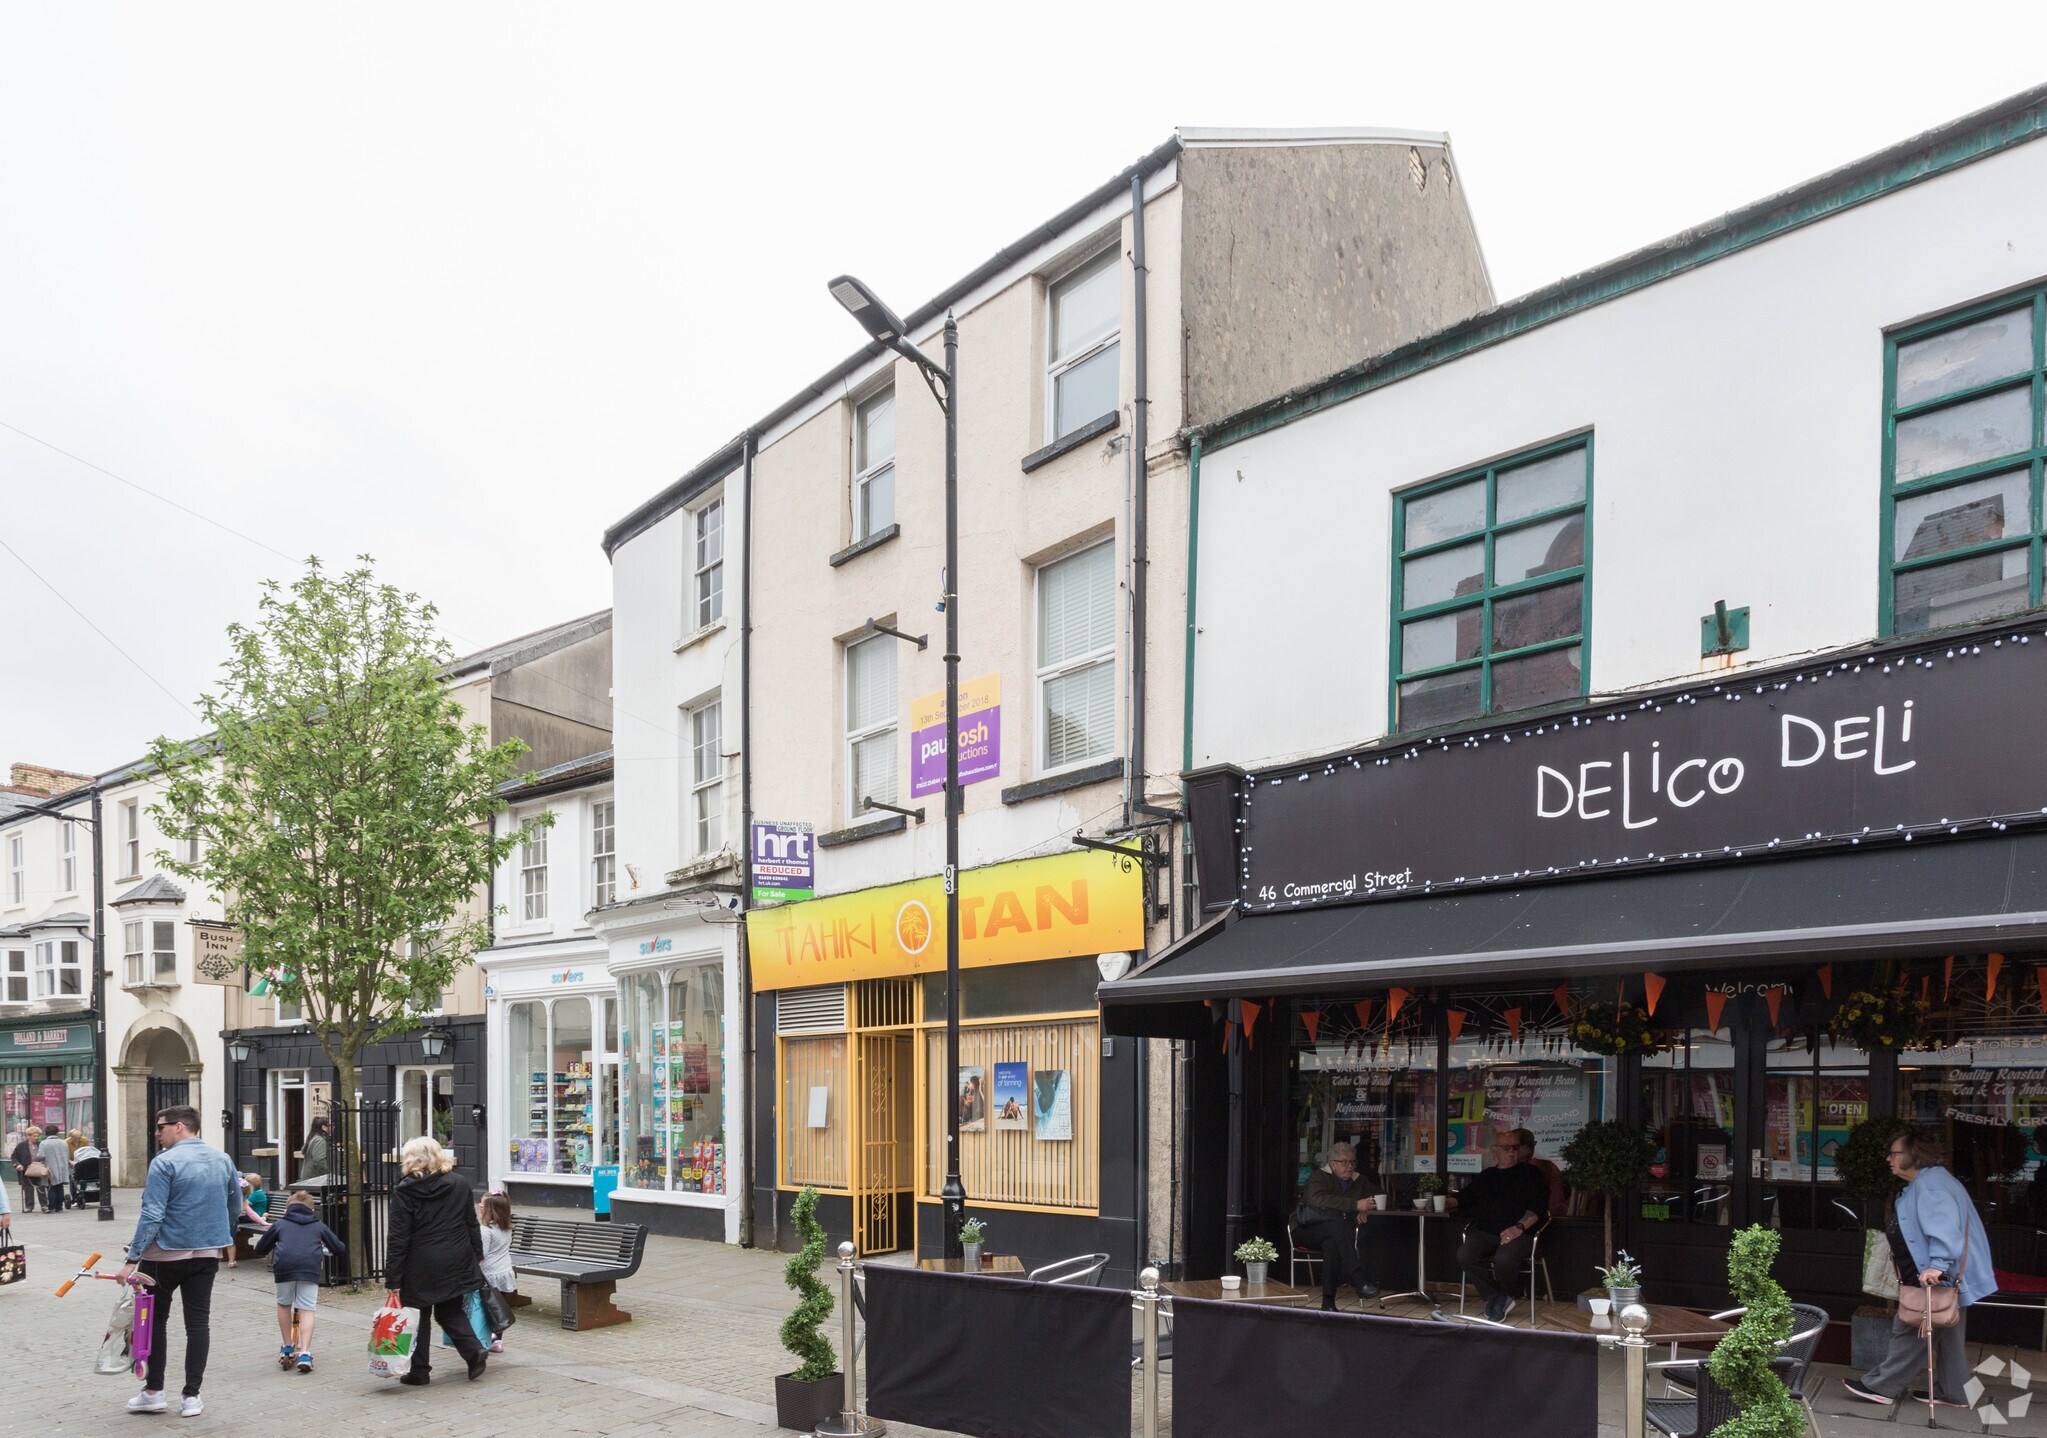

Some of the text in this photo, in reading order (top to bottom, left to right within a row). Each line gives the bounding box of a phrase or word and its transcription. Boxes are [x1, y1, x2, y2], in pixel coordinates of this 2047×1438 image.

[935, 702, 970, 719] Sepber
[972, 695, 989, 708] 2018
[921, 721, 988, 764] pau osh
[958, 745, 988, 761] uctions
[757, 827, 809, 859] hrt
[760, 866, 803, 875] REDUCED
[1258, 885, 1277, 901] 46
[1284, 874, 1357, 898] Commercial
[775, 879, 1089, 965] TAHIKI TAN
[639, 936, 672, 955] savers
[551, 969, 584, 984] savers
[1318, 1063, 1329, 1073] A
[1335, 1062, 1382, 1073] VARIETY
[1947, 1067, 2047, 1083] Quality Roasted
[1003, 1080, 1022, 1088] tanning
[1331, 1074, 1393, 1086] Take Out Food
[1483, 1075, 1577, 1088] Quality Roasted Bean
[1356, 1090, 1367, 1099] &
[1486, 1088, 1573, 1099] Tea & Tea Infusions
[1951, 1083, 1975, 1095] Tea
[1977, 1084, 1988, 1096] &
[1992, 1083, 2015, 1095] Tea
[1335, 1102, 1387, 1115] Refreshments
[1482, 1107, 1580, 1123] FRESHLY GROUND
[1828, 1103, 1862, 1115] OPEN
[1944, 1107, 2011, 1126] FRESHLY
